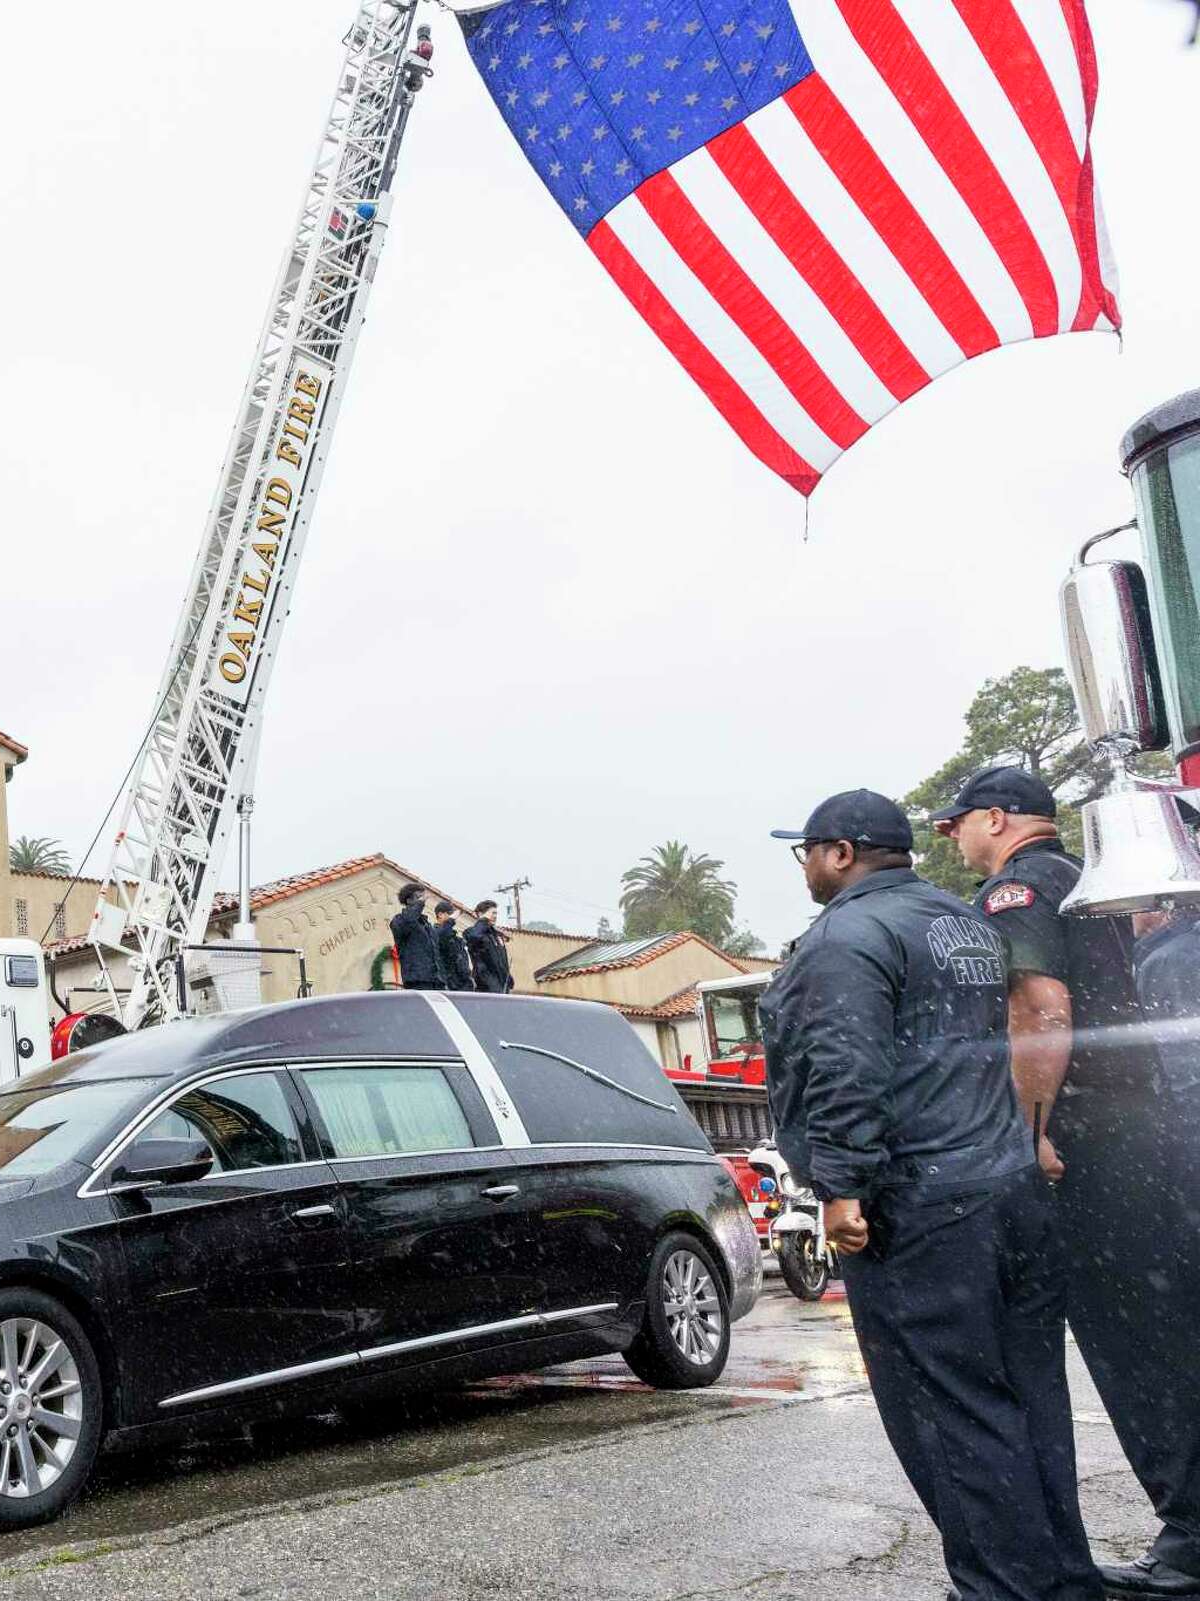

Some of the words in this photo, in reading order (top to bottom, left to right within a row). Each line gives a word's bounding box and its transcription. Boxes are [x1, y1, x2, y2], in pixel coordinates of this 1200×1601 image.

[218, 477, 293, 684] OAKLAND
[276, 368, 323, 471] FIRE
[319, 923, 357, 956] CHAPEL
[363, 917, 376, 932] OF
[950, 956, 1003, 984] FIRE
